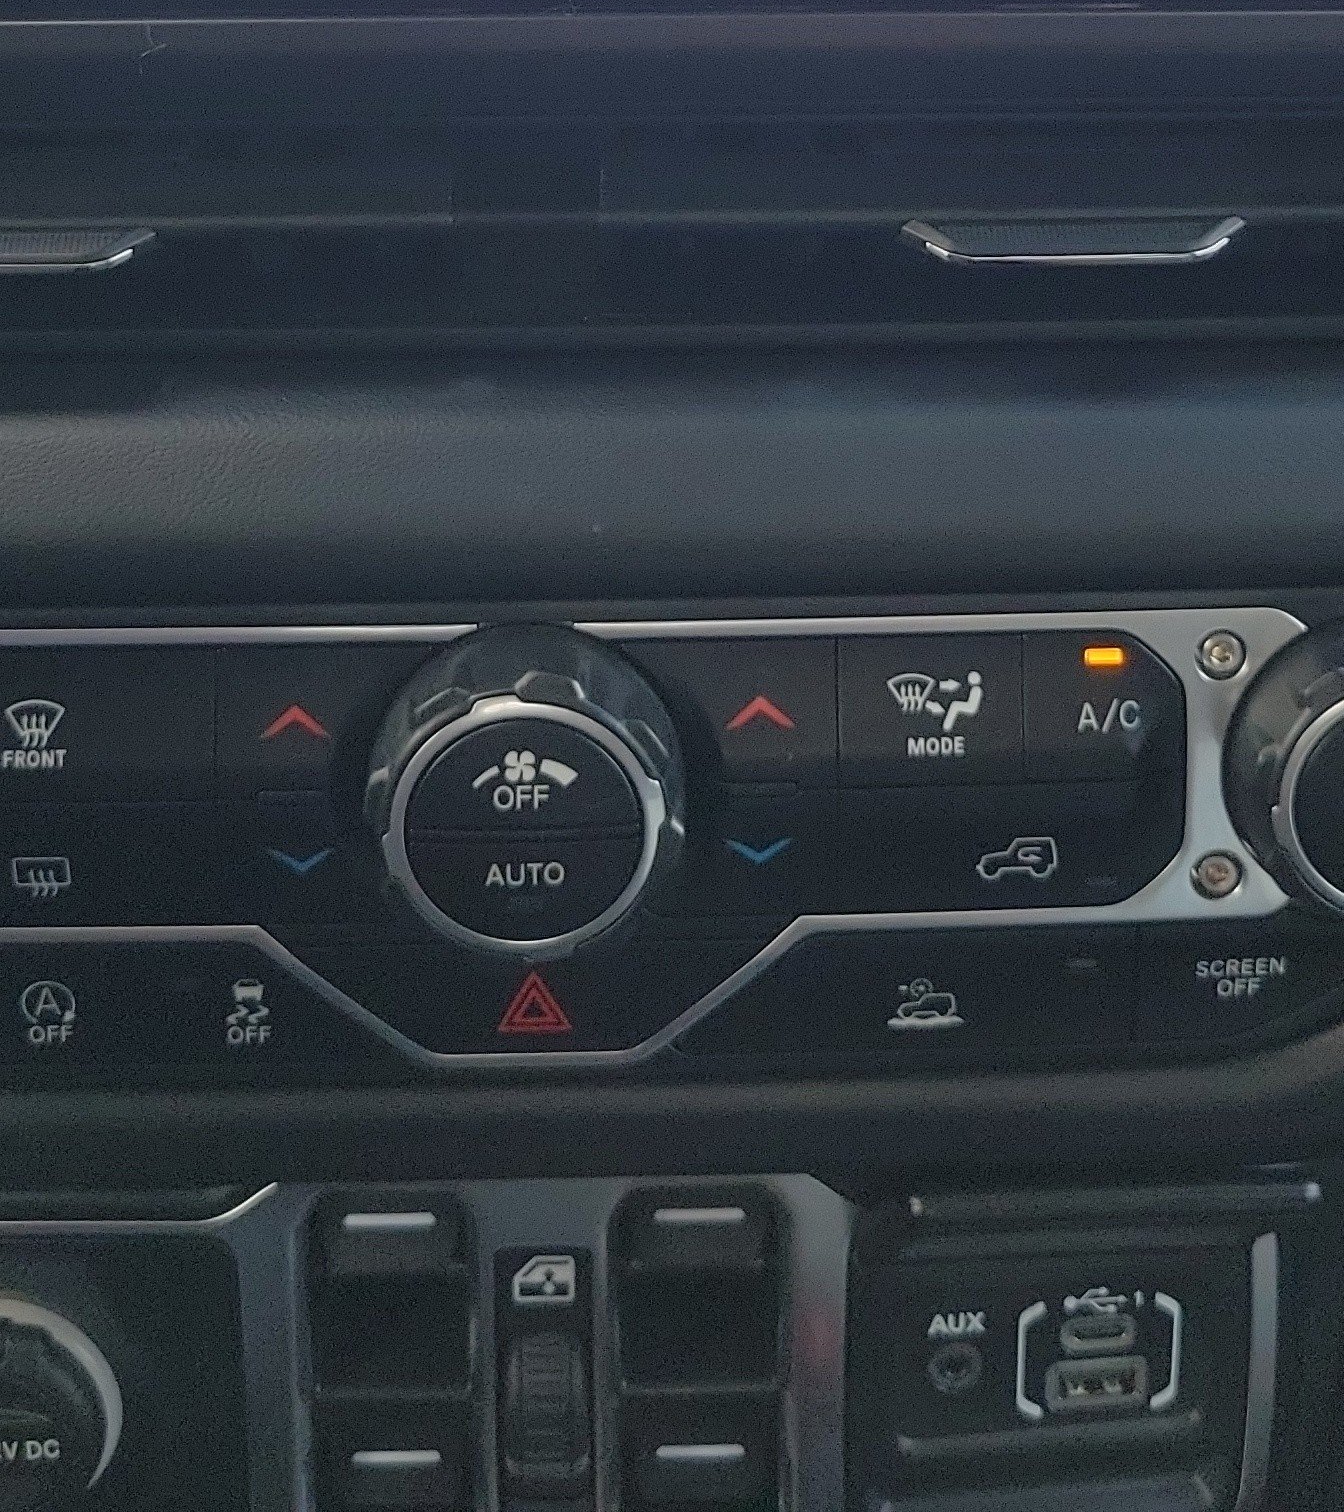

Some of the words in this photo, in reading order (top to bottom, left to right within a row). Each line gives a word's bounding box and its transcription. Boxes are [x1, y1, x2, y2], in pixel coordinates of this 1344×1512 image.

[1077, 698, 1142, 734] A/C
[907, 736, 966, 756] MODE
[1, 749, 68, 770] FRONT
[492, 784, 551, 813] OFF
[485, 861, 566, 887] AUTO
[1195, 956, 1287, 976] SCREEN
[1216, 977, 1261, 998] OFF
[28, 1024, 74, 1044] OFF
[226, 1024, 272, 1045] OFF
[927, 1310, 987, 1337] AUX
[25, 1439, 62, 1461] DC
